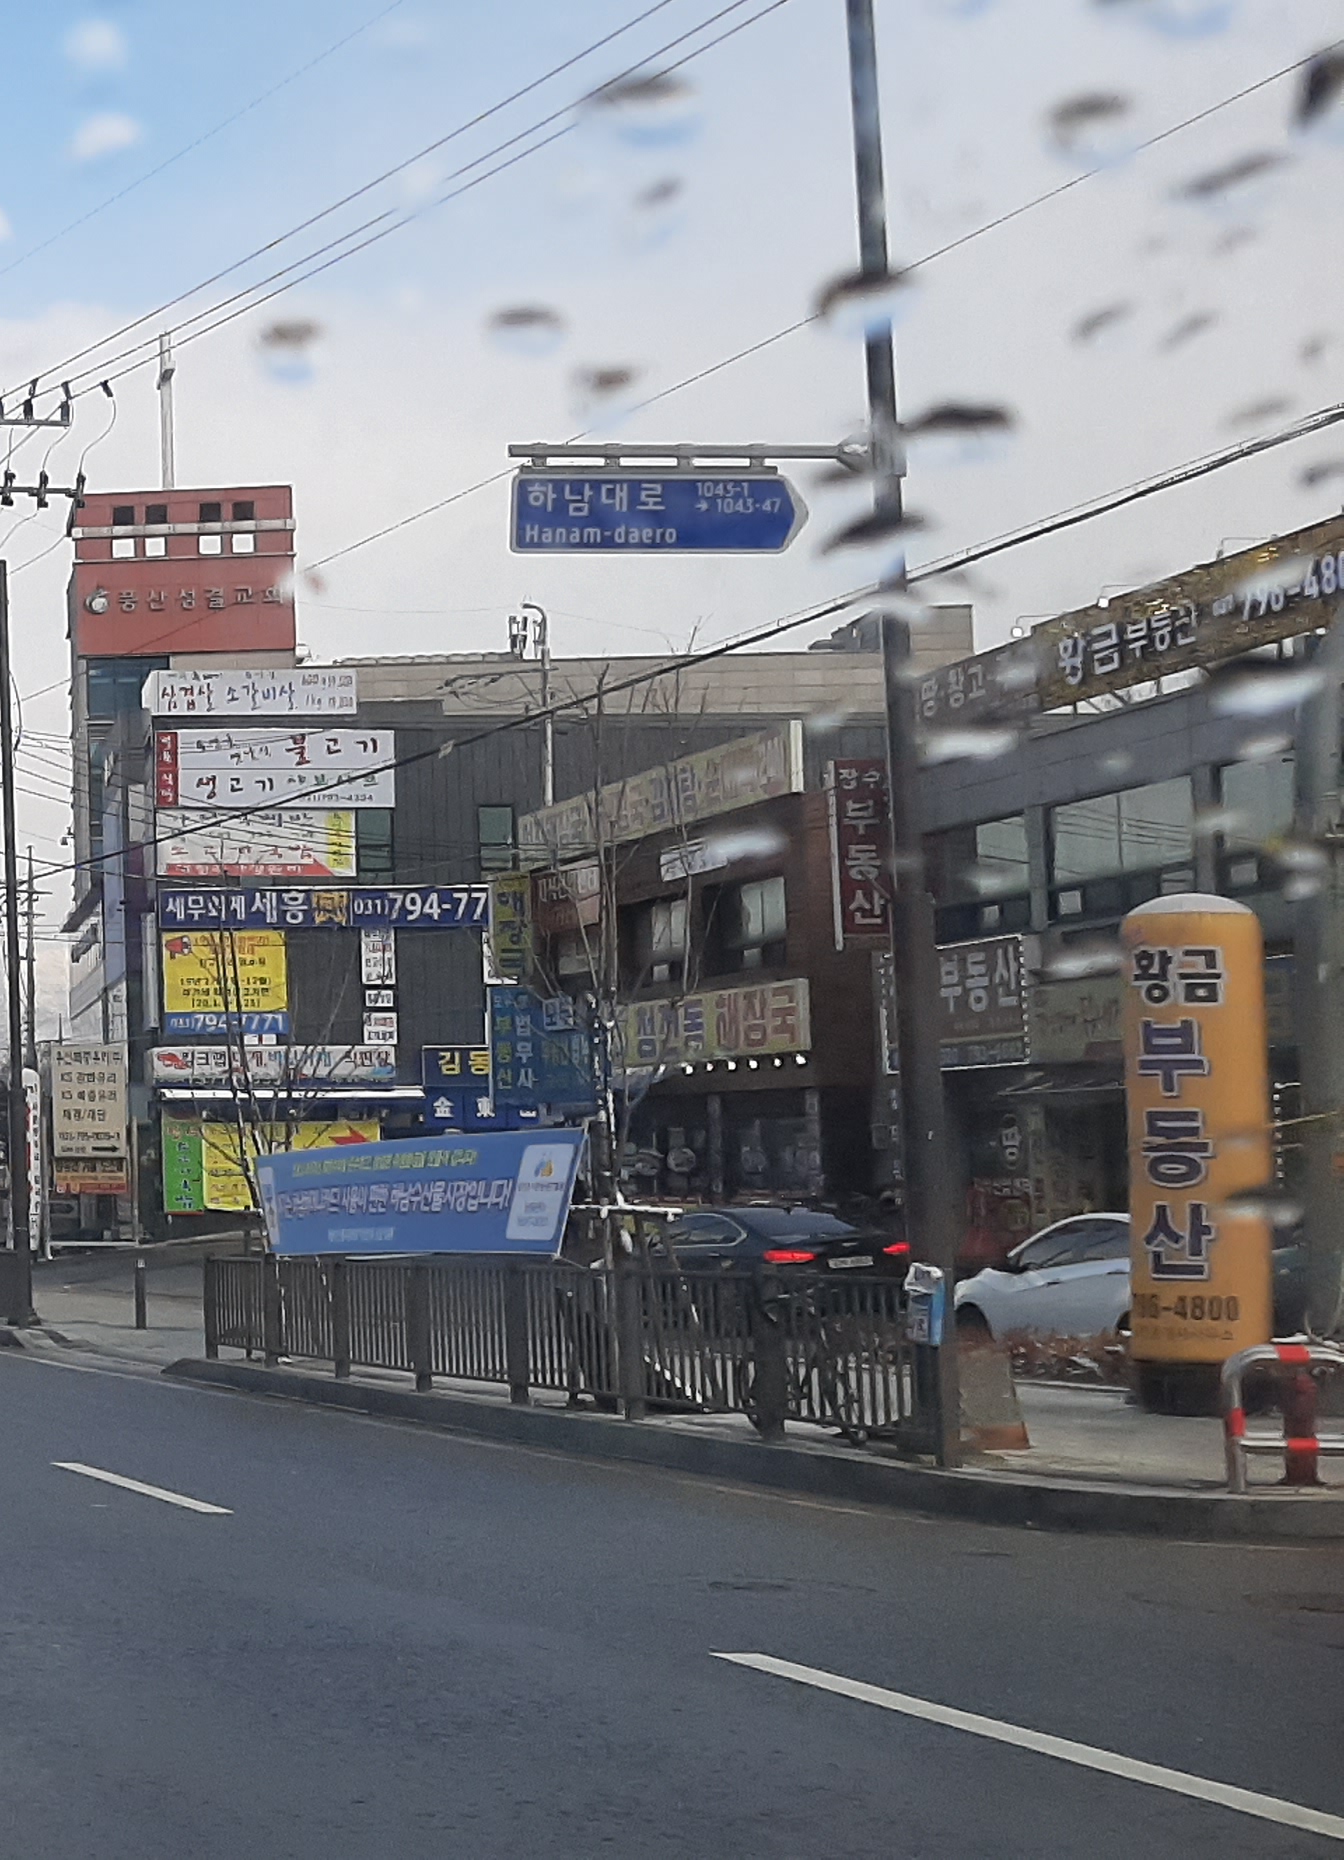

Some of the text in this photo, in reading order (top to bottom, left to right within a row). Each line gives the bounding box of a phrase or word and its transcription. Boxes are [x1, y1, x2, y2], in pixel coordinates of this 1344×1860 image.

[527, 482, 666, 517] 하남대로
[525, 524, 678, 545] Hanam-daero
[1058, 624, 1119, 685] 황금
[1124, 601, 1199, 659] 부동산
[196, 774, 274, 799] 생고기
[843, 799, 886, 925] 부동산
[939, 944, 1019, 1013] 부동산
[1131, 945, 1224, 1006] 황금
[715, 984, 797, 1050] 해장국
[1137, 1017, 1216, 1282] 부동산
